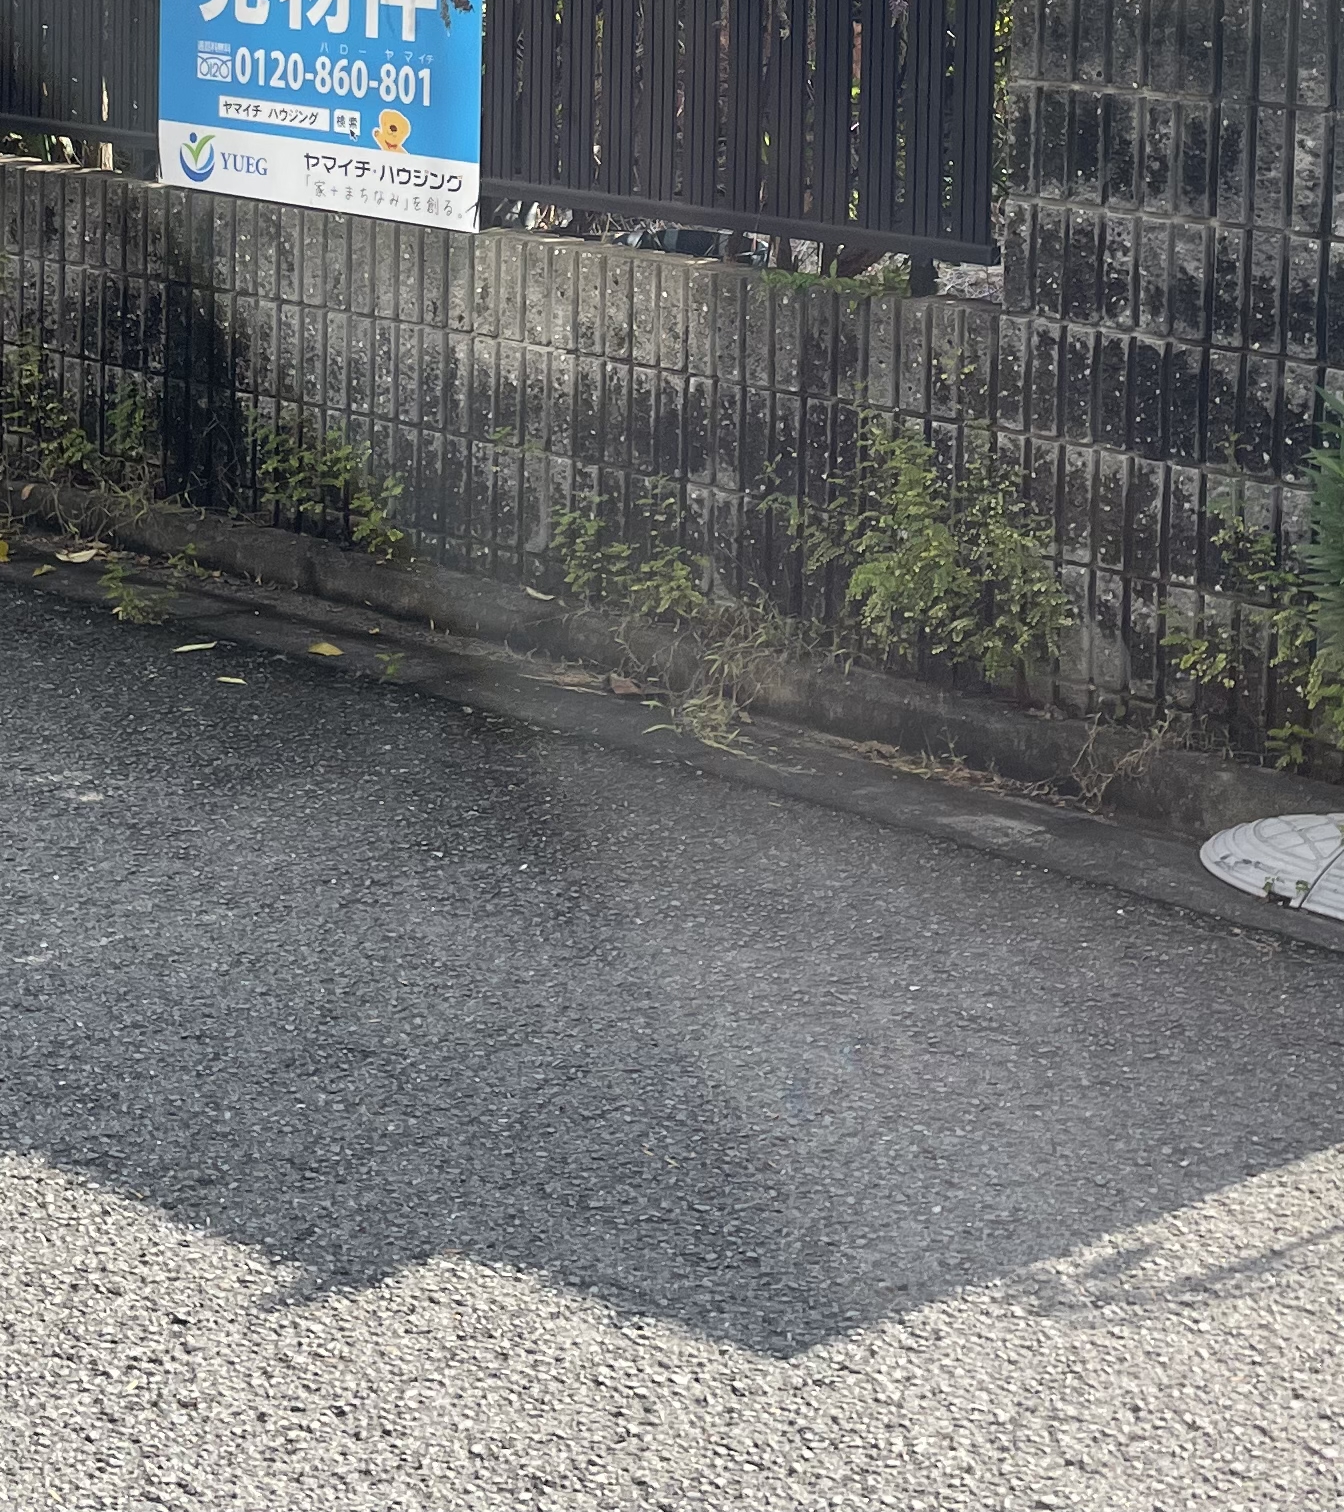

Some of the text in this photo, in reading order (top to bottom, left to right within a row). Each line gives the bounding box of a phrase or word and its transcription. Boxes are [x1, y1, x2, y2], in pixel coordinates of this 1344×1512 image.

[235, 46, 431, 106] 0120-860-801
[223, 100, 319, 125] ヤマイチ ハウジング
[220, 151, 268, 176] YUEG
[304, 153, 463, 192] ヤマイチ・ハウジング
